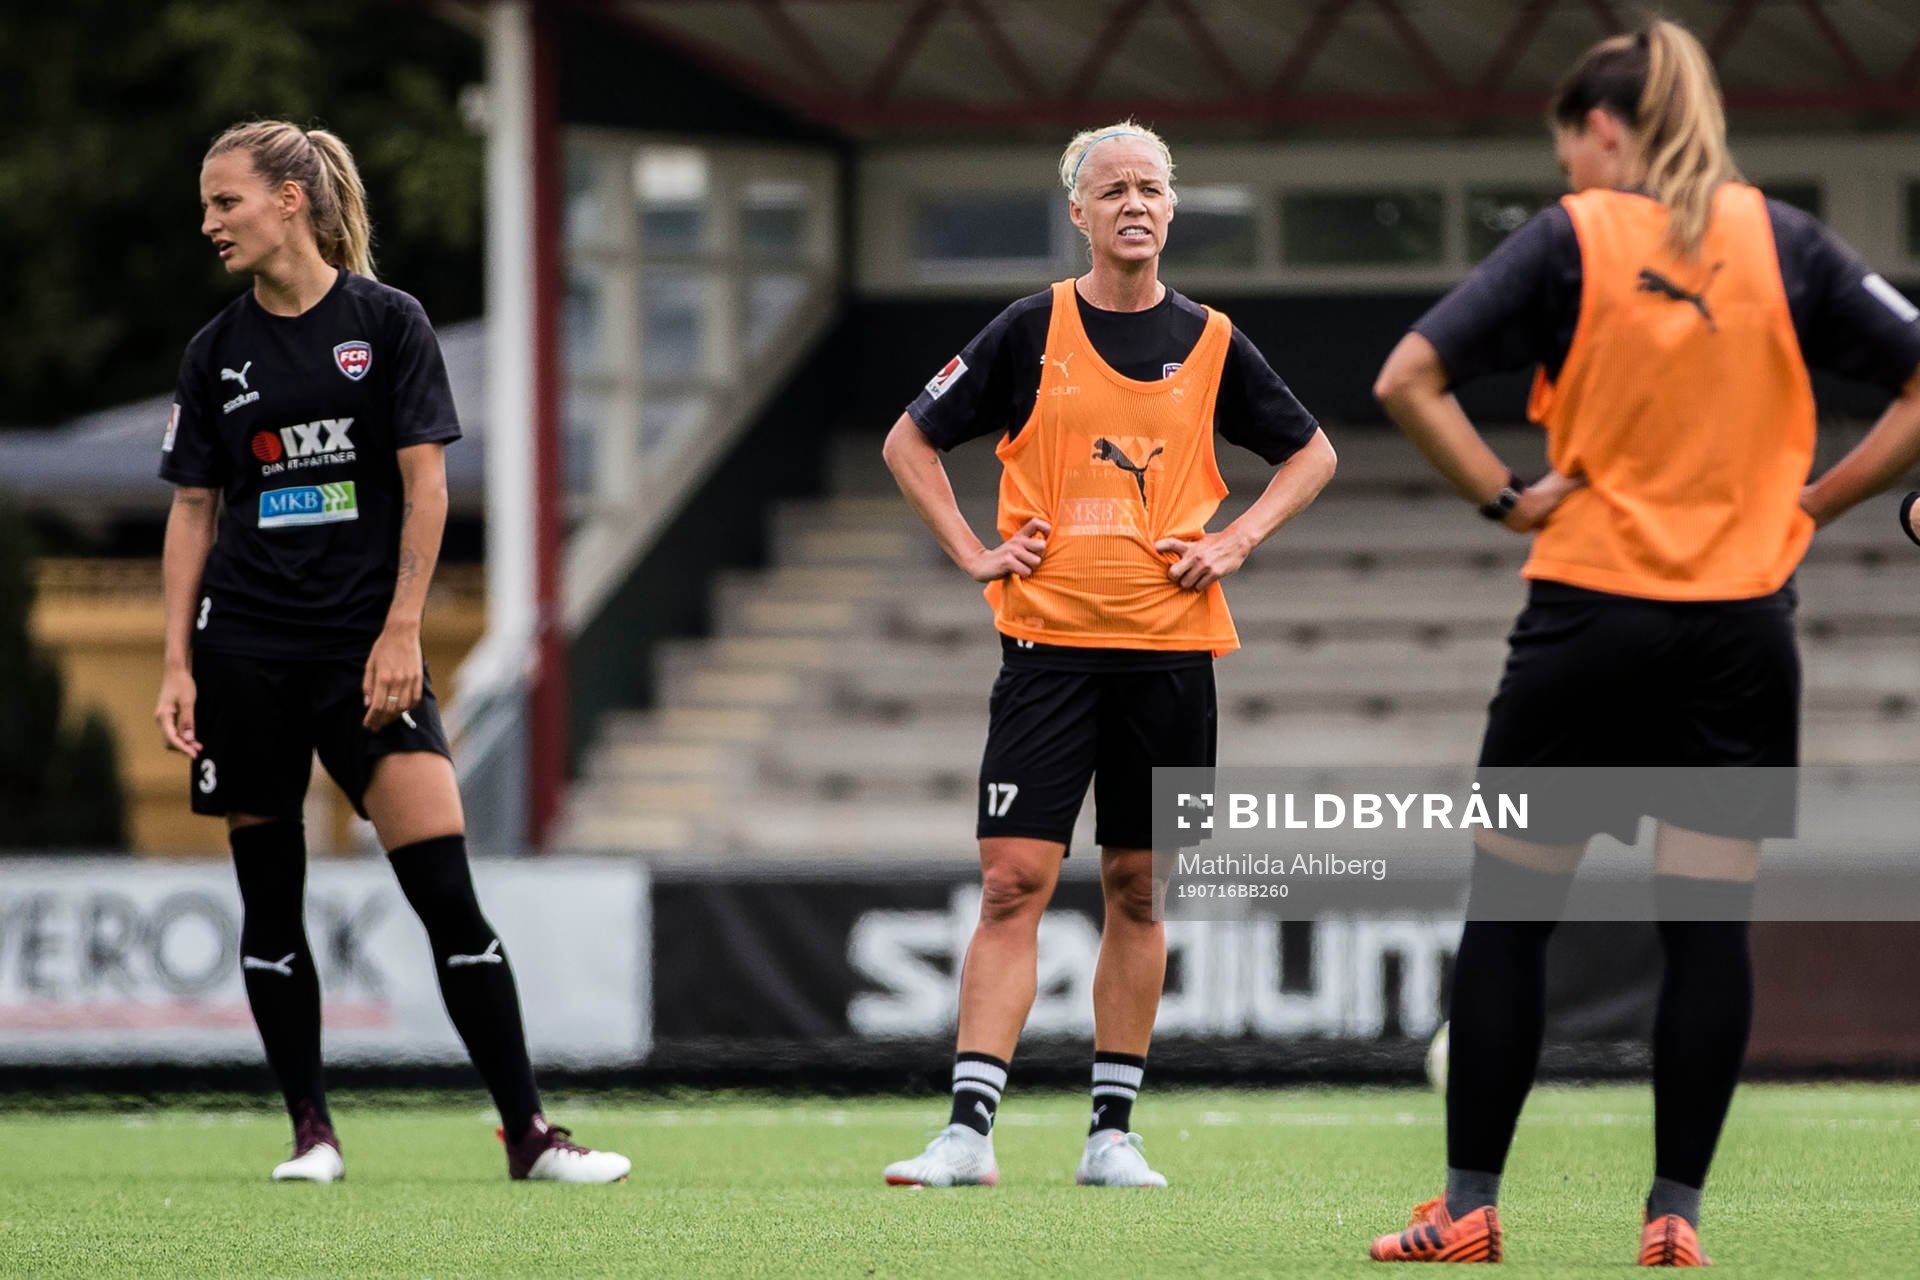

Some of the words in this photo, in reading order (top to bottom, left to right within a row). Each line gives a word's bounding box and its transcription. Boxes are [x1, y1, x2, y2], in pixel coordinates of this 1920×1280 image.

[341, 350, 368, 362] FCR
[280, 417, 355, 459] IXX
[261, 463, 285, 477] DIN
[287, 450, 357, 471] IT-PARTNER
[268, 491, 319, 513] MKB
[197, 596, 212, 630] 3
[199, 758, 217, 794] 3
[987, 782, 1019, 817] 17
[0, 888, 392, 994] EROK
